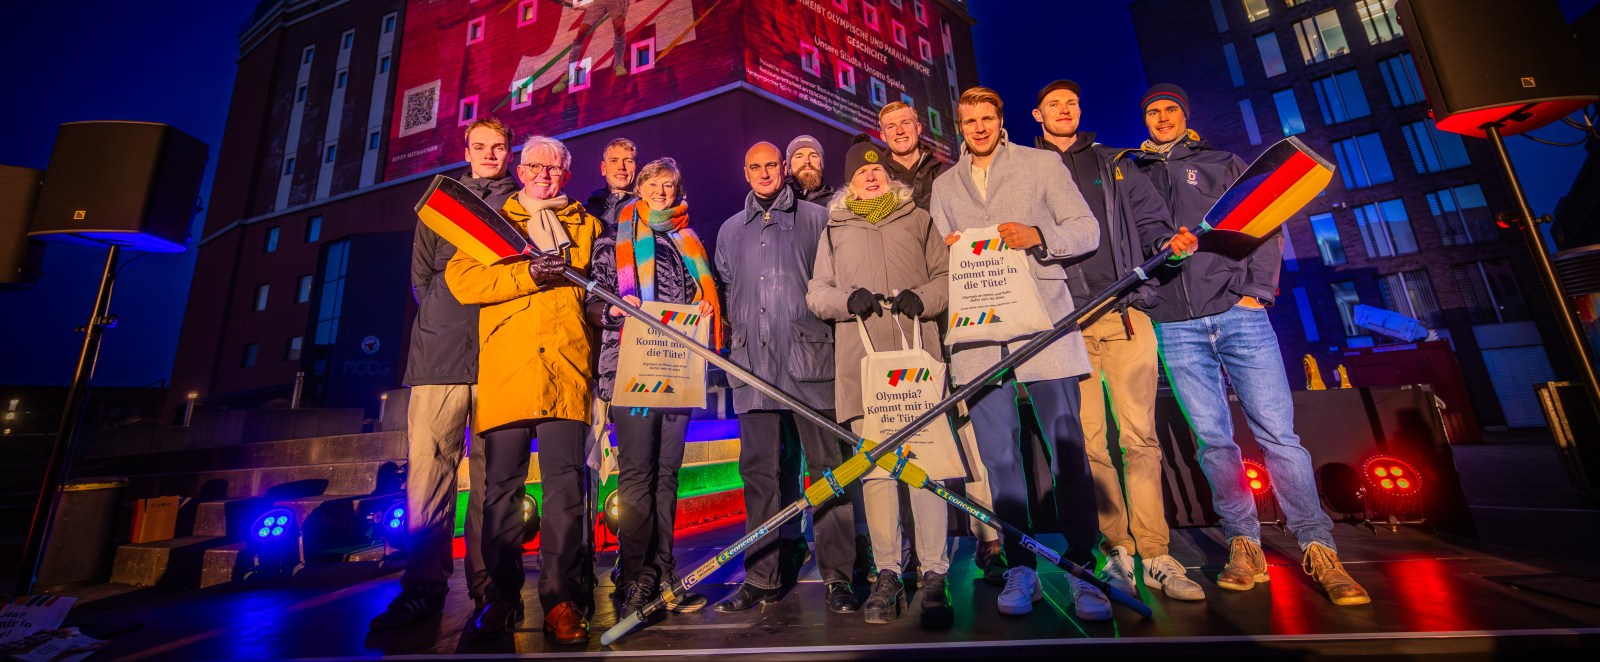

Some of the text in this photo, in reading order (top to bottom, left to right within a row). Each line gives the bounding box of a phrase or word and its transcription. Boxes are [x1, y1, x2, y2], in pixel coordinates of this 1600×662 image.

[826, 10, 868, 42] OLYMPISCHE
[870, 36, 884, 50] UND
[884, 45, 930, 76] PARALYMPISCHE
[846, 36, 888, 64] GESCHICHTE
[814, 36, 838, 56] Unsere
[864, 63, 886, 80] Unsere
[408, 145, 438, 158] MITMACHEN
[960, 257, 1004, 269] Olympia?
[952, 270, 985, 282] Kommt
[988, 268, 1005, 276] mir
[964, 278, 1007, 289] die Tüte!
[636, 338, 668, 347] Kommt
[647, 348, 686, 359] die Tüte!
[876, 389, 922, 402] Olympia?
[867, 401, 935, 414] Kommt mir in
[881, 413, 923, 423] die Tüte
[948, 495, 980, 516] concept
[729, 532, 758, 555] concept
